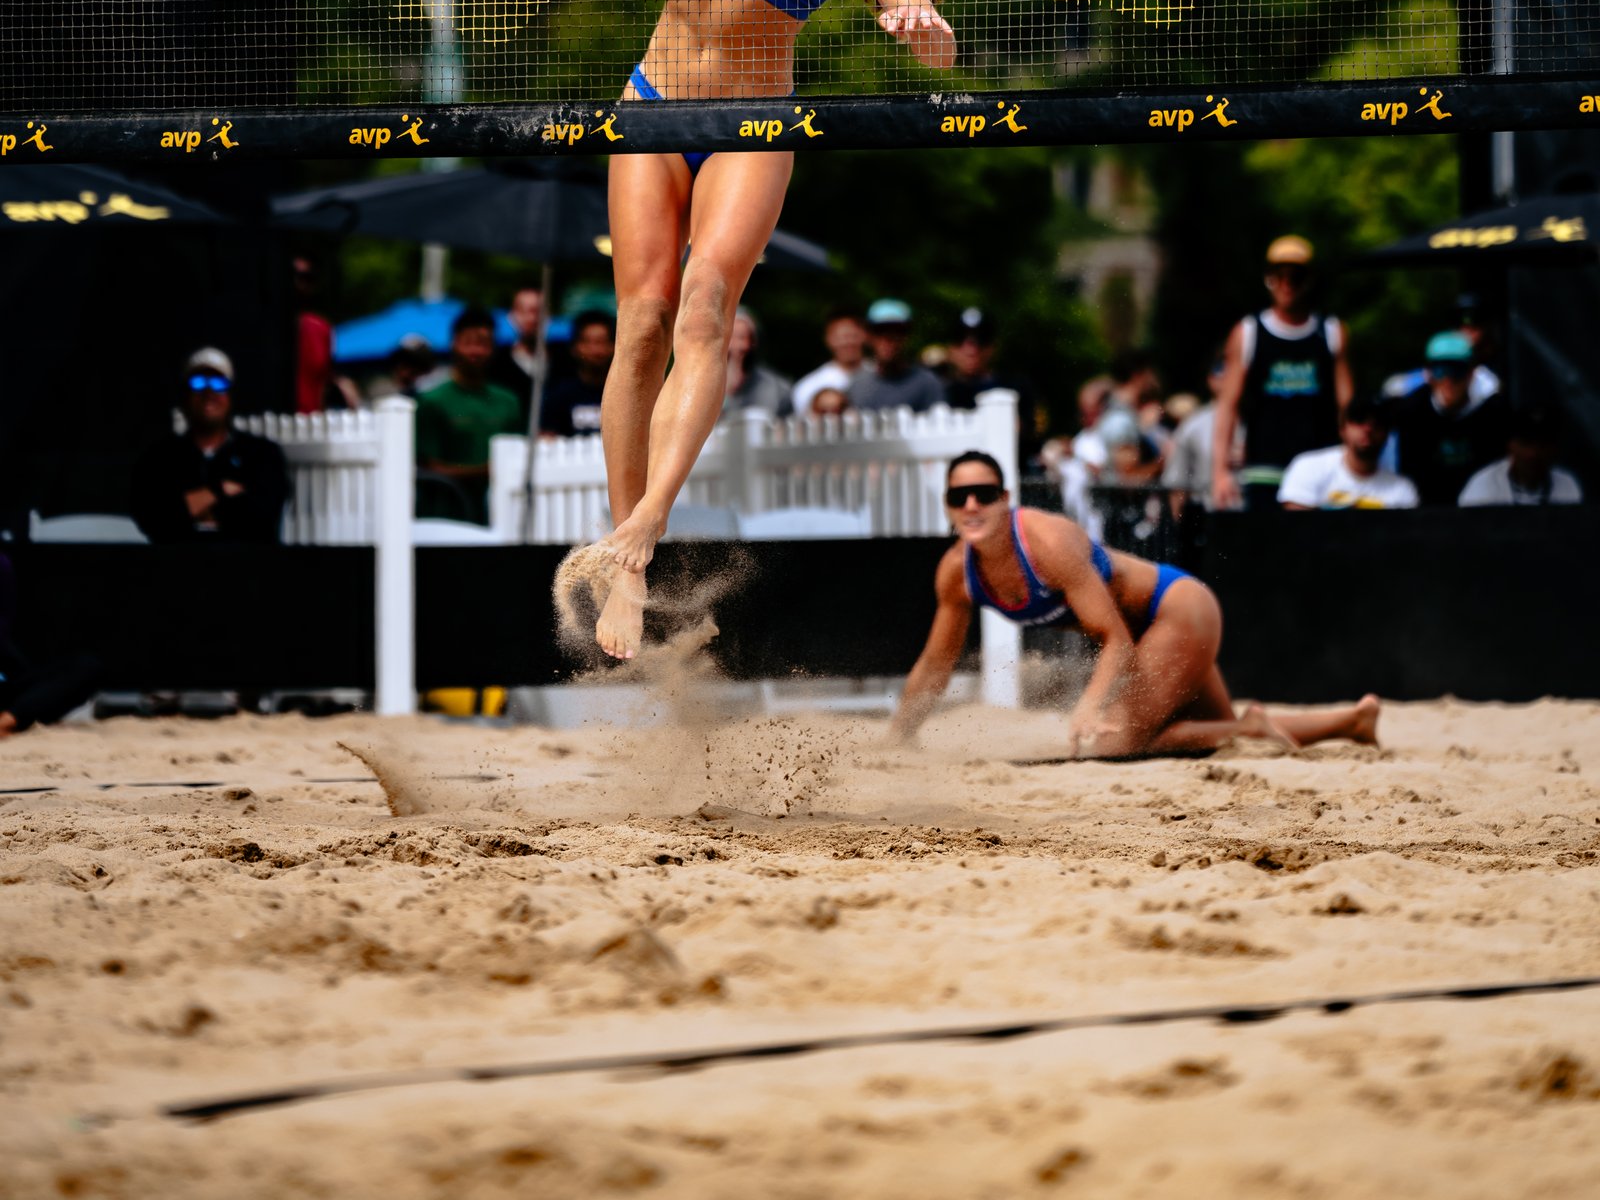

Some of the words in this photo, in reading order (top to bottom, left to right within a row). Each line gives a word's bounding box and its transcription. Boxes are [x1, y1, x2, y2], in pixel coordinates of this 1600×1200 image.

[1148, 109, 1195, 132] avp
[1360, 102, 1408, 126] avp
[541, 123, 585, 146] avp
[738, 119, 783, 143] avp
[940, 115, 986, 138] avp
[160, 131, 202, 153] avp
[348, 127, 392, 150] avp
